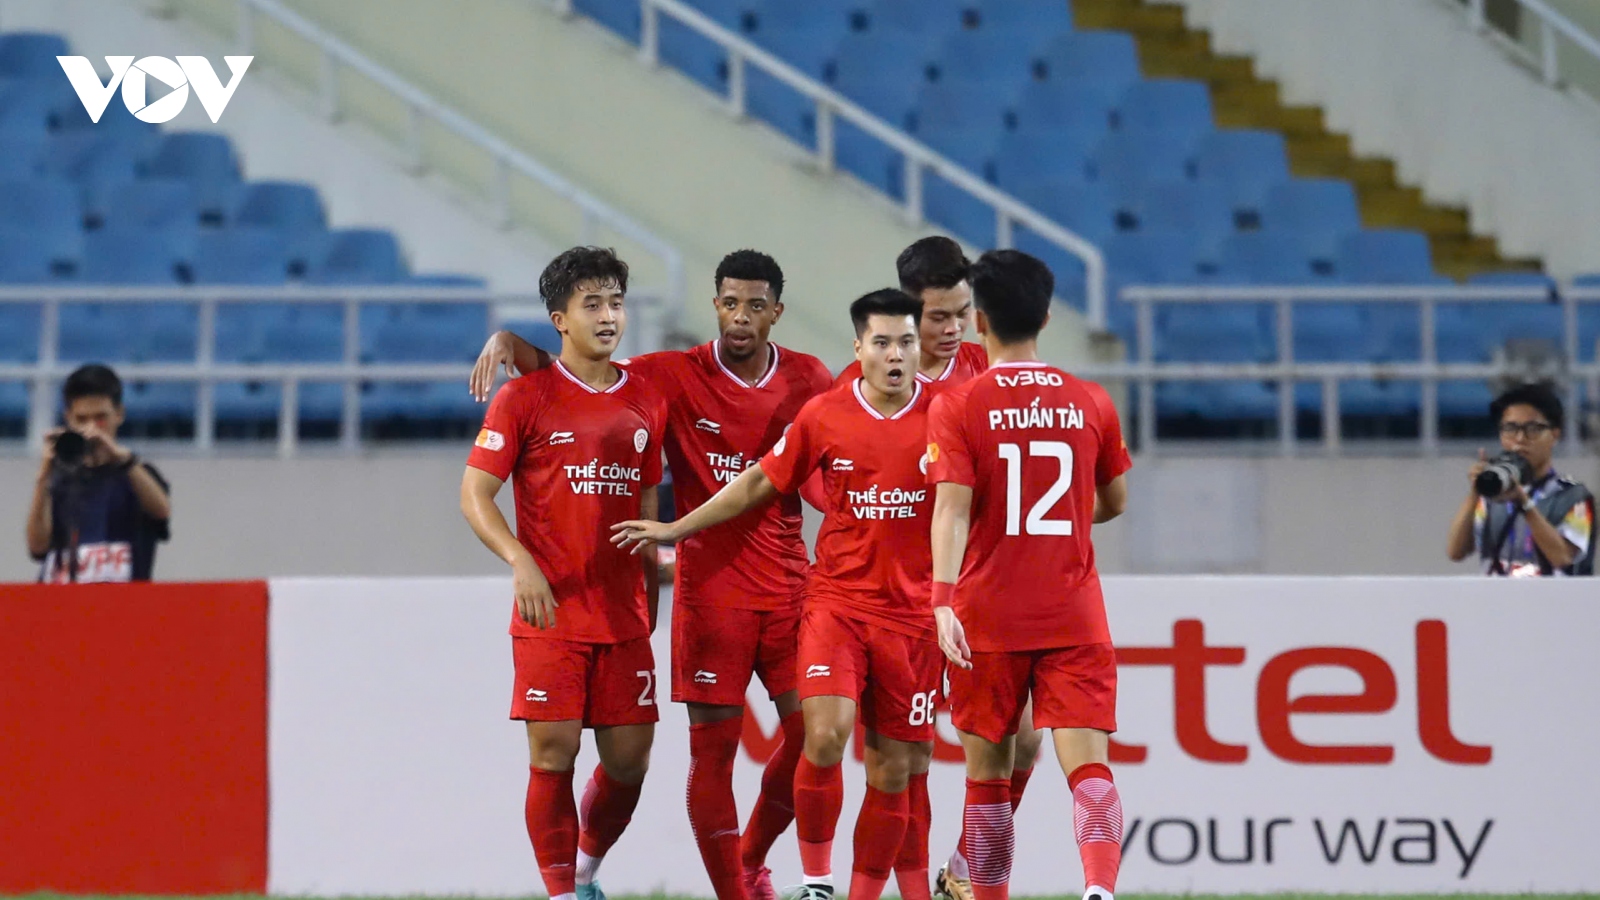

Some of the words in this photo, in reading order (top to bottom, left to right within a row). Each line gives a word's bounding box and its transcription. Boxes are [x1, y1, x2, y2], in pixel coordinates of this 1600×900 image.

[995, 371, 1063, 387] tv360
[989, 397, 1053, 430] P.TUẤN
[1056, 403, 1084, 429] TÀI
[563, 458, 598, 479] THỂ
[599, 462, 641, 481] CÔNG
[706, 452, 743, 470] THỂ
[570, 481, 633, 496] VIETTEL
[846, 484, 878, 504] THỂ
[880, 487, 926, 504] CÔNG
[998, 441, 1074, 536] 12
[852, 505, 917, 520] VIETTEL
[636, 670, 657, 706] 2
[741, 618, 1493, 765] vtel
[1313, 817, 1494, 878] way
